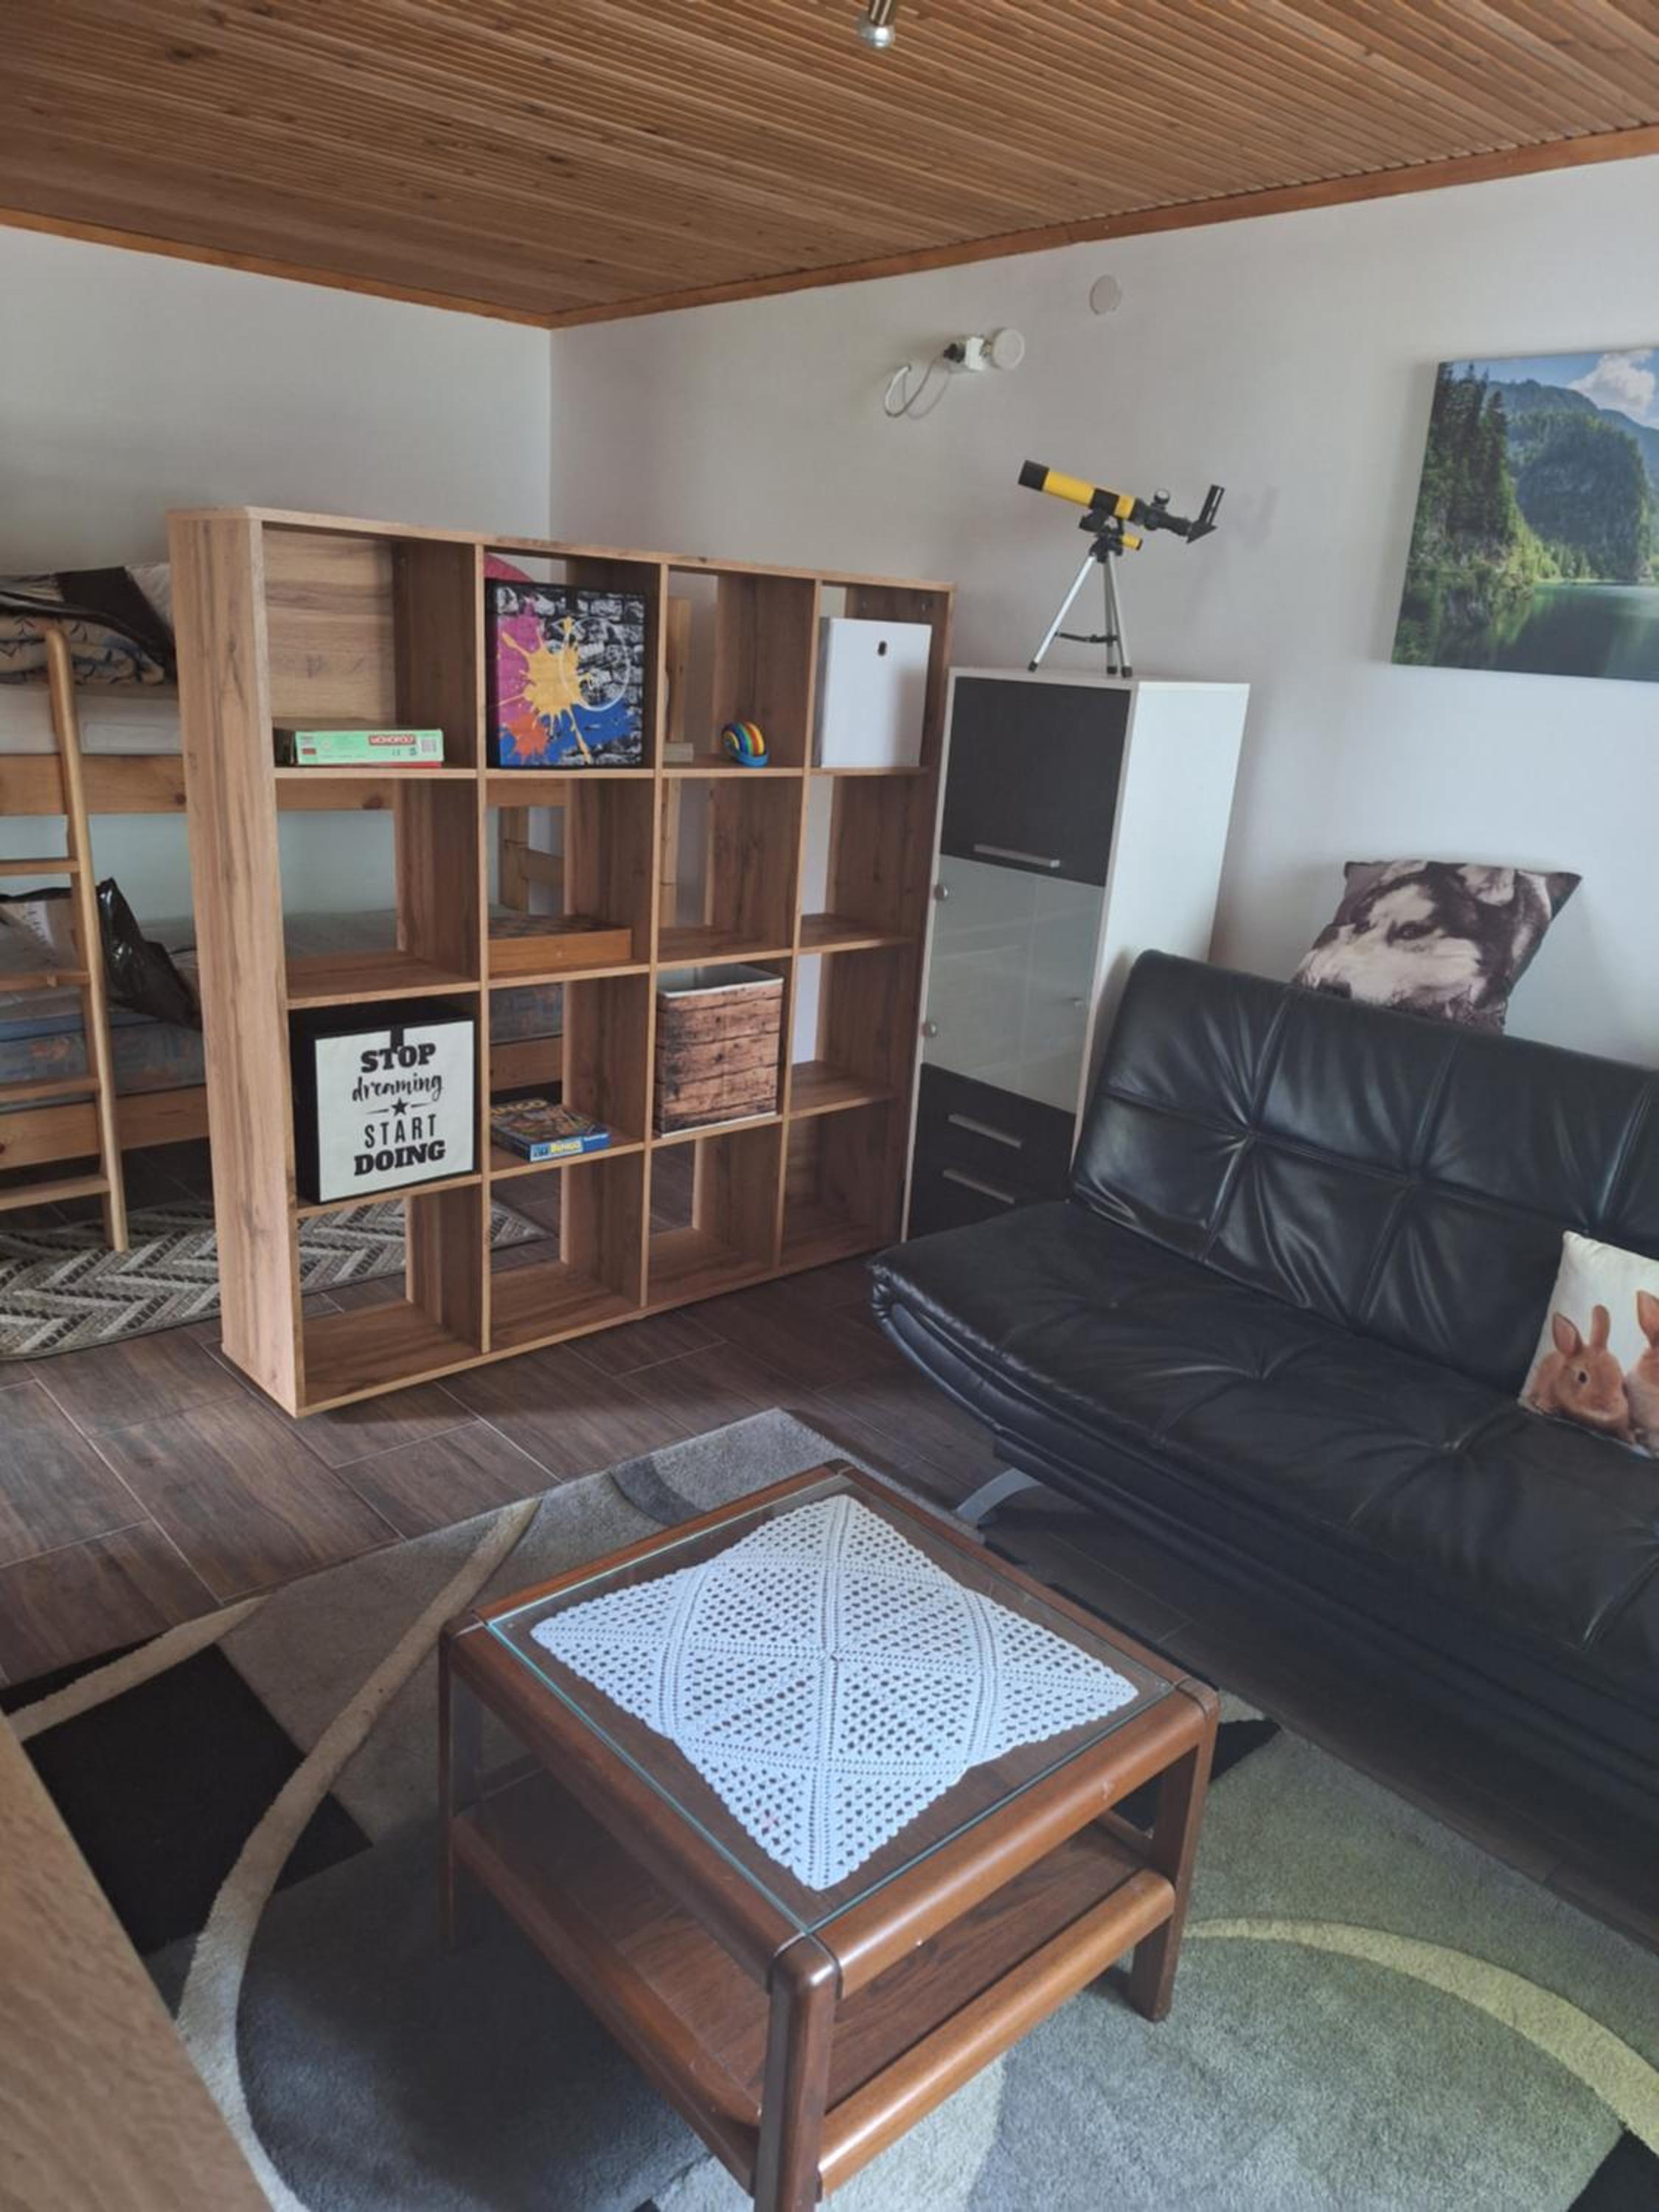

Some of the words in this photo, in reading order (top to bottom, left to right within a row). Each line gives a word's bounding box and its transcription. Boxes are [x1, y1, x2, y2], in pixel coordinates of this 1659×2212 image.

[361, 1043, 437, 1073] STOP
[352, 1073, 442, 1102] dreaming
[364, 1114, 437, 1149] START
[354, 1141, 446, 1176] DOING
